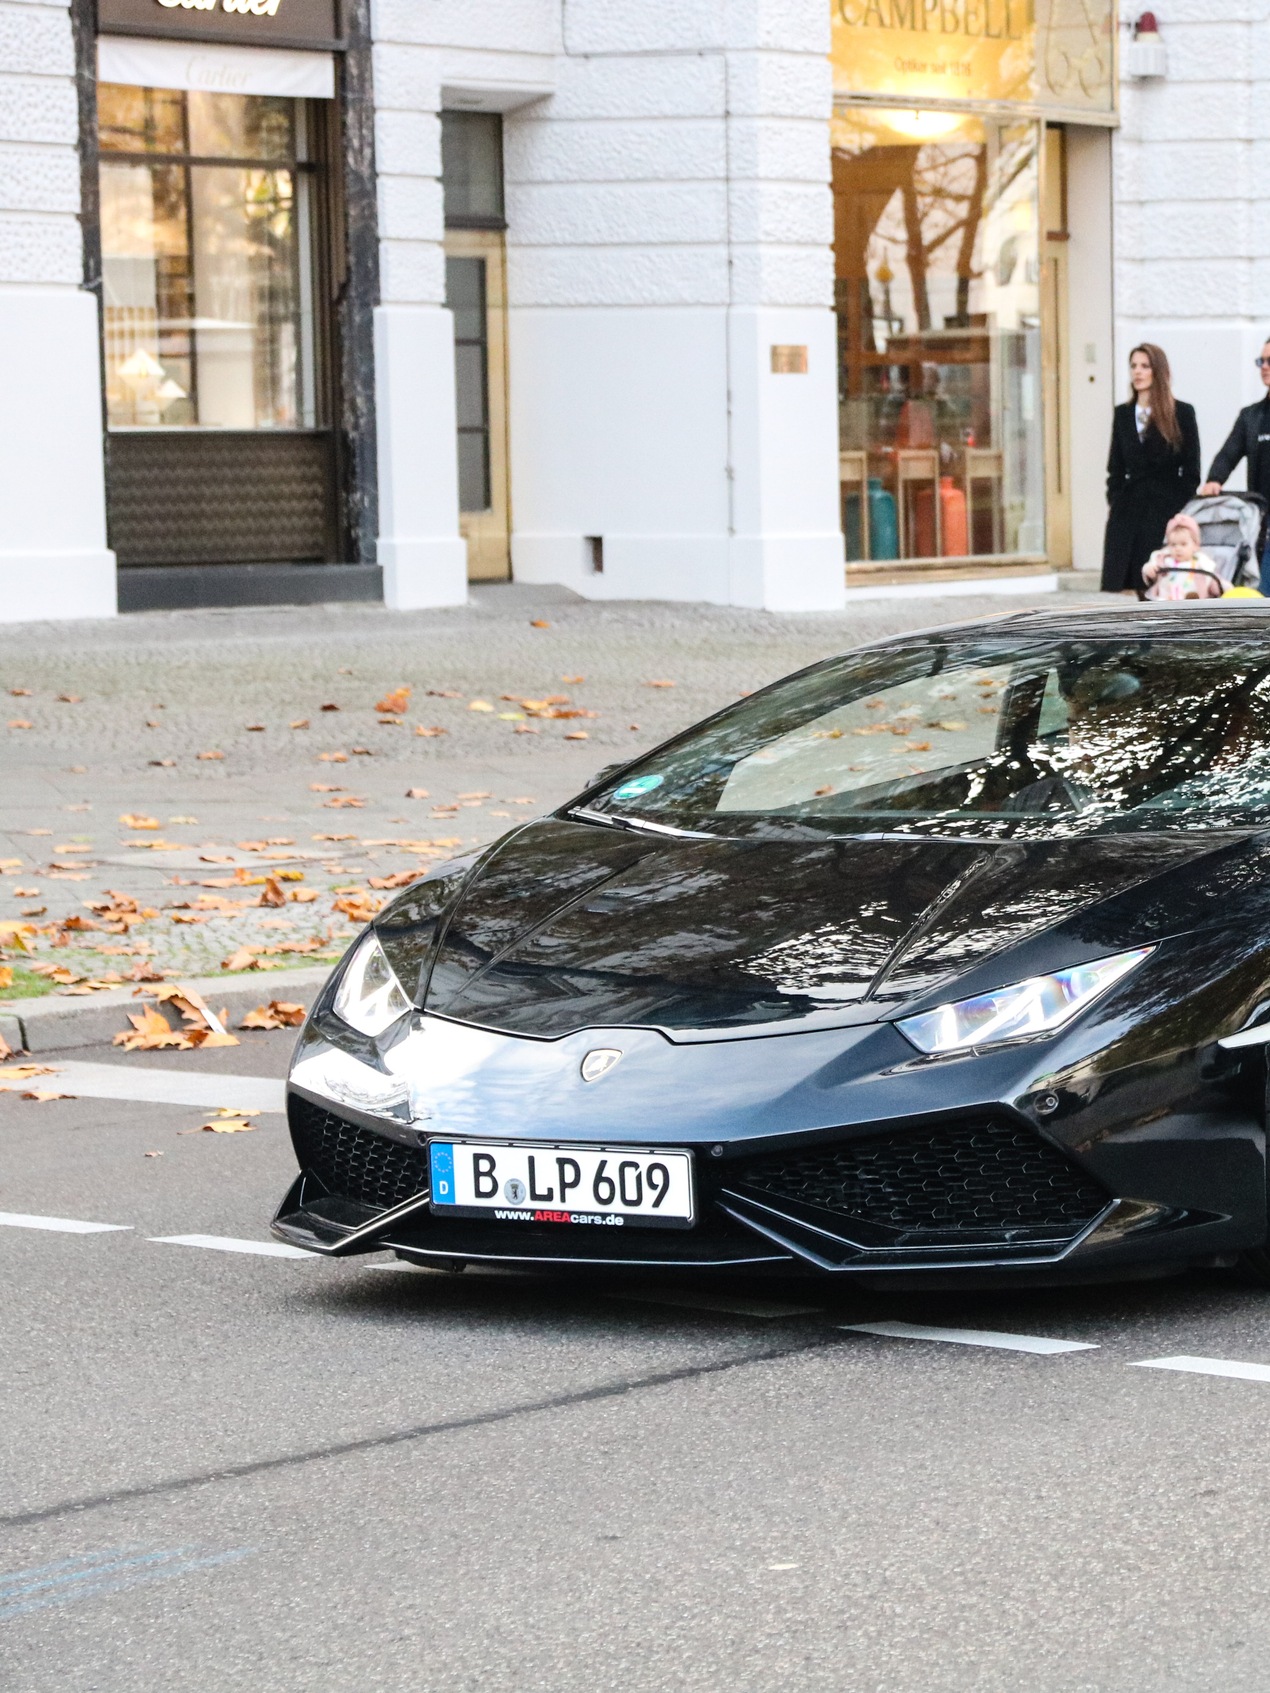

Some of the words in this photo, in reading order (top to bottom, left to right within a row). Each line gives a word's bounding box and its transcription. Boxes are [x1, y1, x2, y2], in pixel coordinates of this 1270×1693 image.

[186, 56, 252, 87] Cartier
[439, 1180, 449, 1196] D
[473, 1153, 499, 1199] B
[528, 1155, 582, 1203] LP
[592, 1159, 670, 1208] 609
[494, 1210, 624, 1226] www.AREAcars.de
